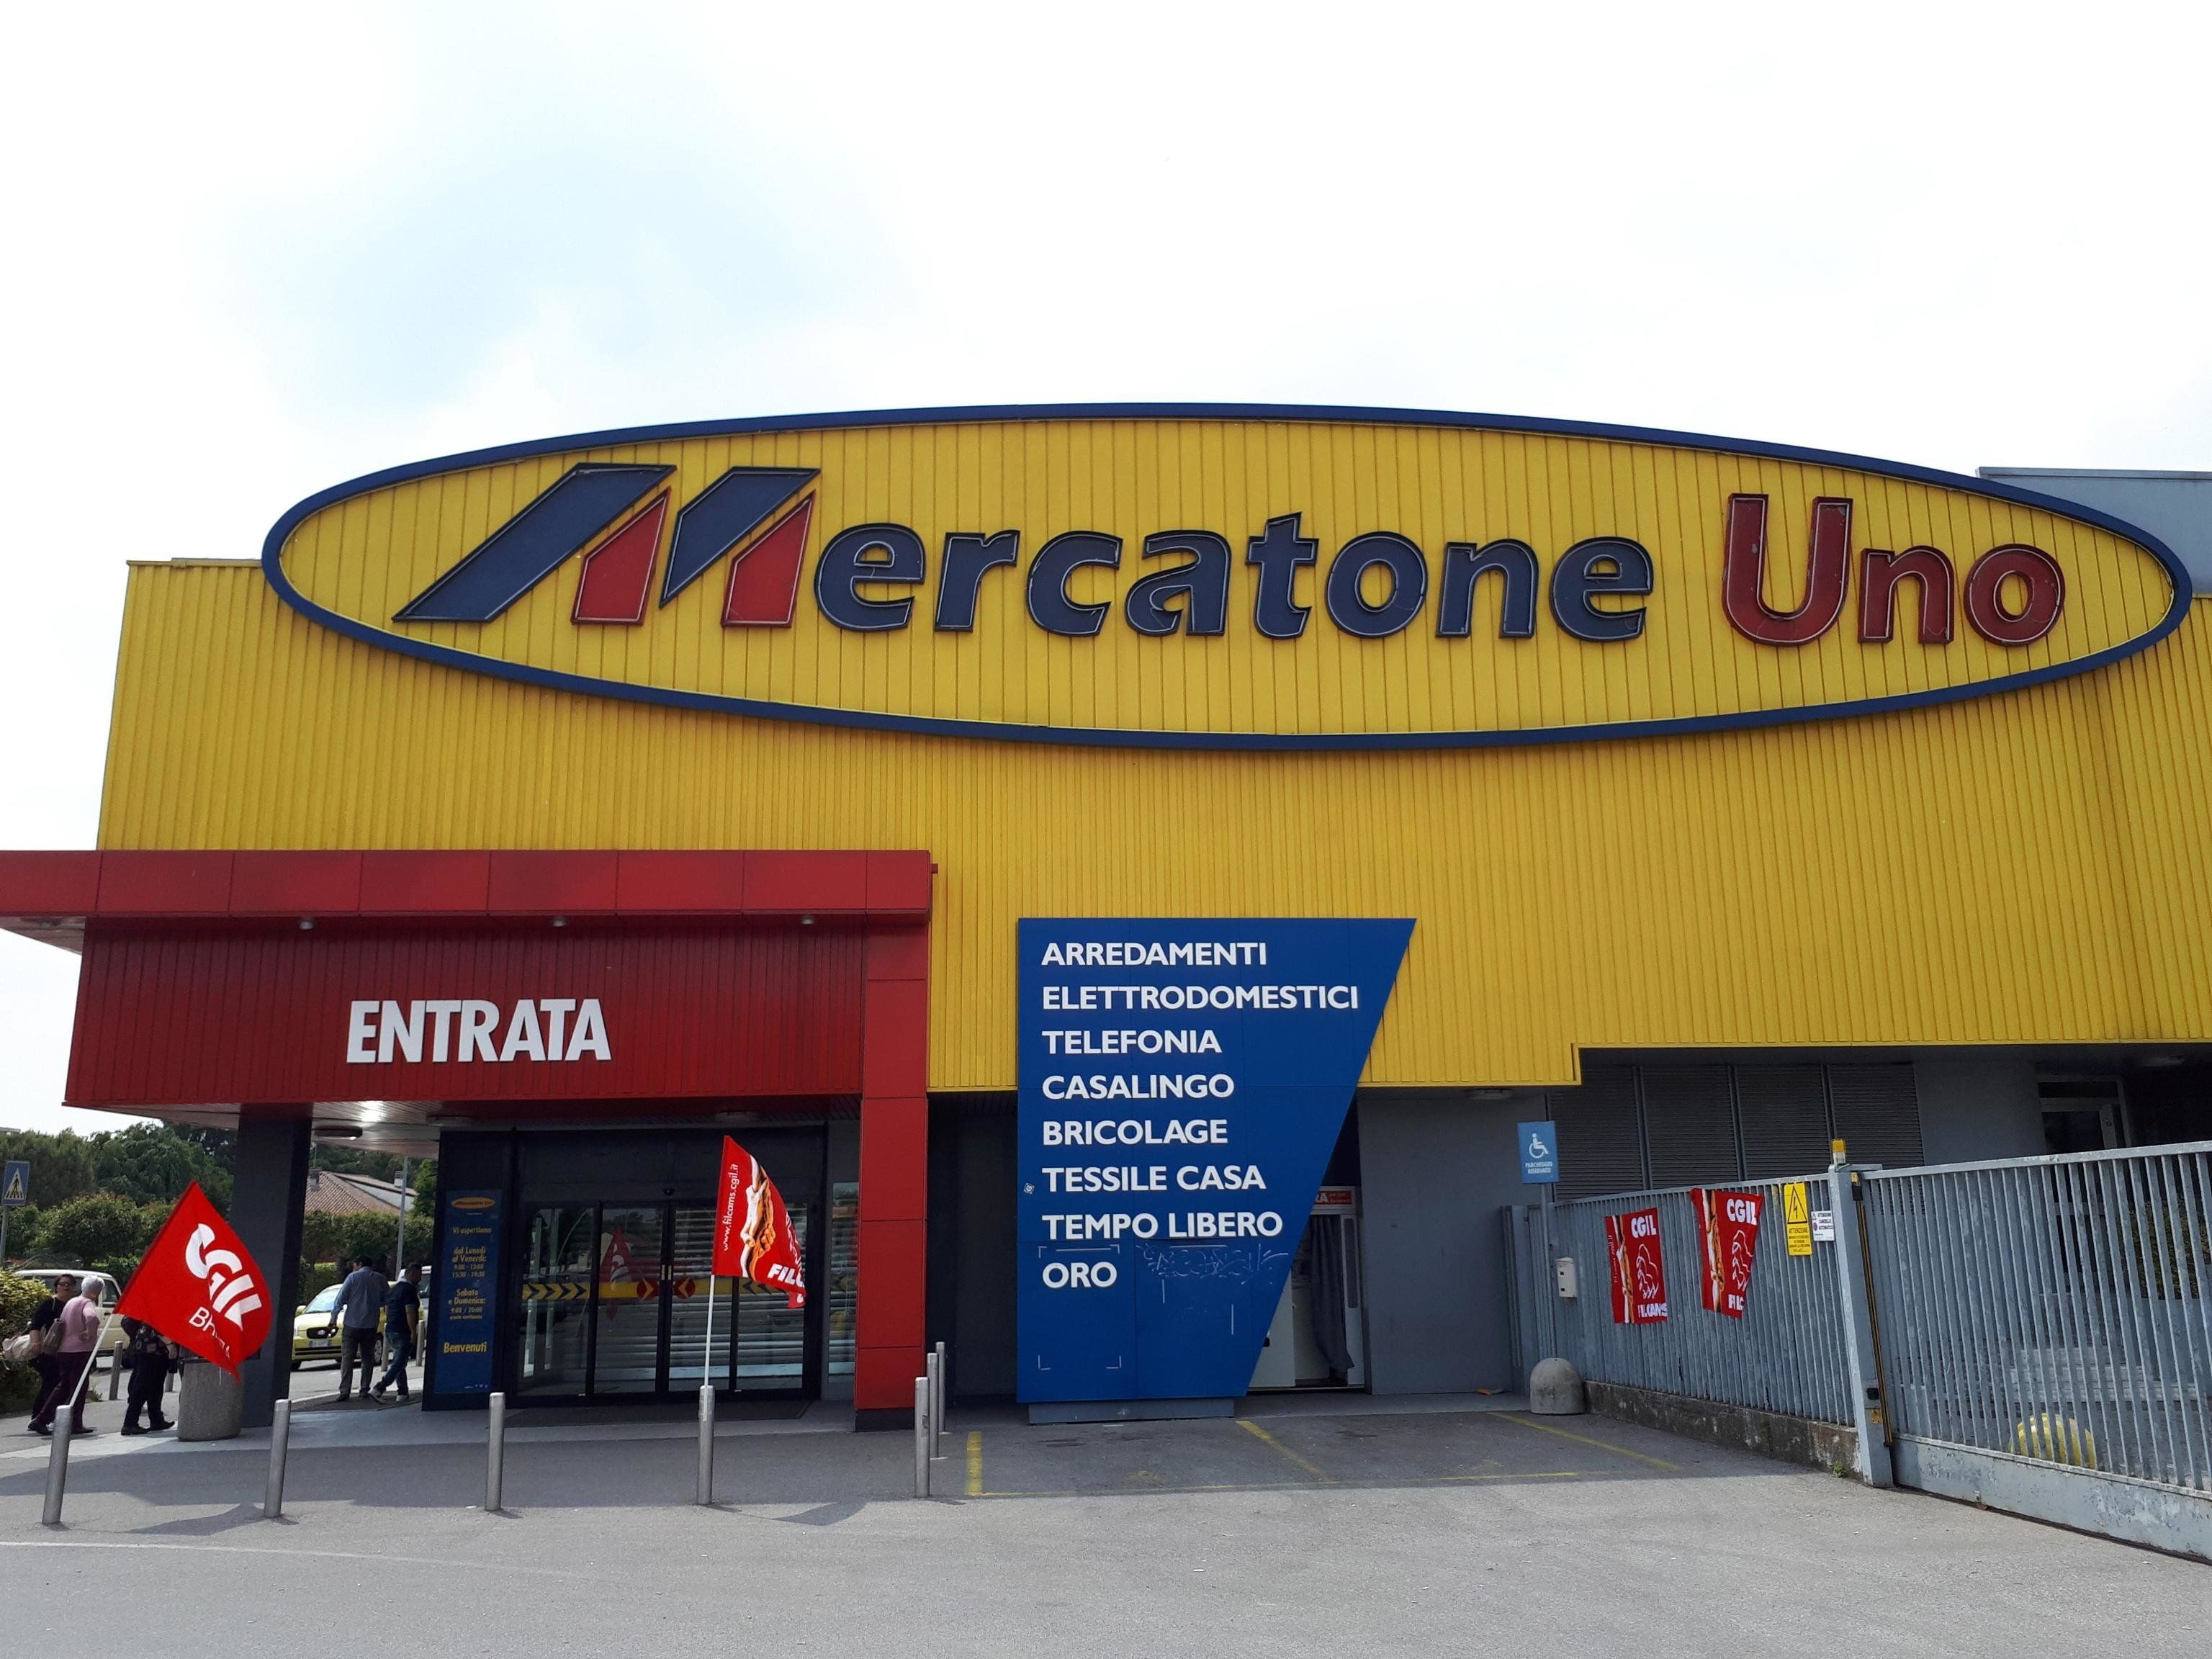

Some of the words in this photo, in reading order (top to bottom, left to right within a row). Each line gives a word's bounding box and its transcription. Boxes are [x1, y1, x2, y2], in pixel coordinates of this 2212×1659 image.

[392, 462, 1654, 643] Mercatone
[1722, 493, 2066, 647] Uno
[1041, 942, 1267, 966] ARREDAMENTI
[1042, 985, 1359, 1010] ELETTRODOMESTICI
[346, 999, 611, 1064] ENTRATA
[1042, 1030, 1223, 1054] TELEFONIA
[1042, 1074, 1235, 1100] CASALINGO
[1043, 1120, 1228, 1146] BRICOLAGE
[1042, 1166, 1167, 1192] TESSILE
[1176, 1165, 1267, 1190] CASA
[724, 1163, 740, 1252] www.filcams.cgil.it
[1726, 1198, 1758, 1226] CGIL
[1042, 1213, 1159, 1240] TEMPO
[1168, 1211, 1283, 1238] LIBERO
[1631, 1214, 1658, 1238] CGIL
[185, 1223, 263, 1331] CGIL
[1042, 1261, 1118, 1289] ORO
[444, 1341, 487, 1354] Benvenuti
